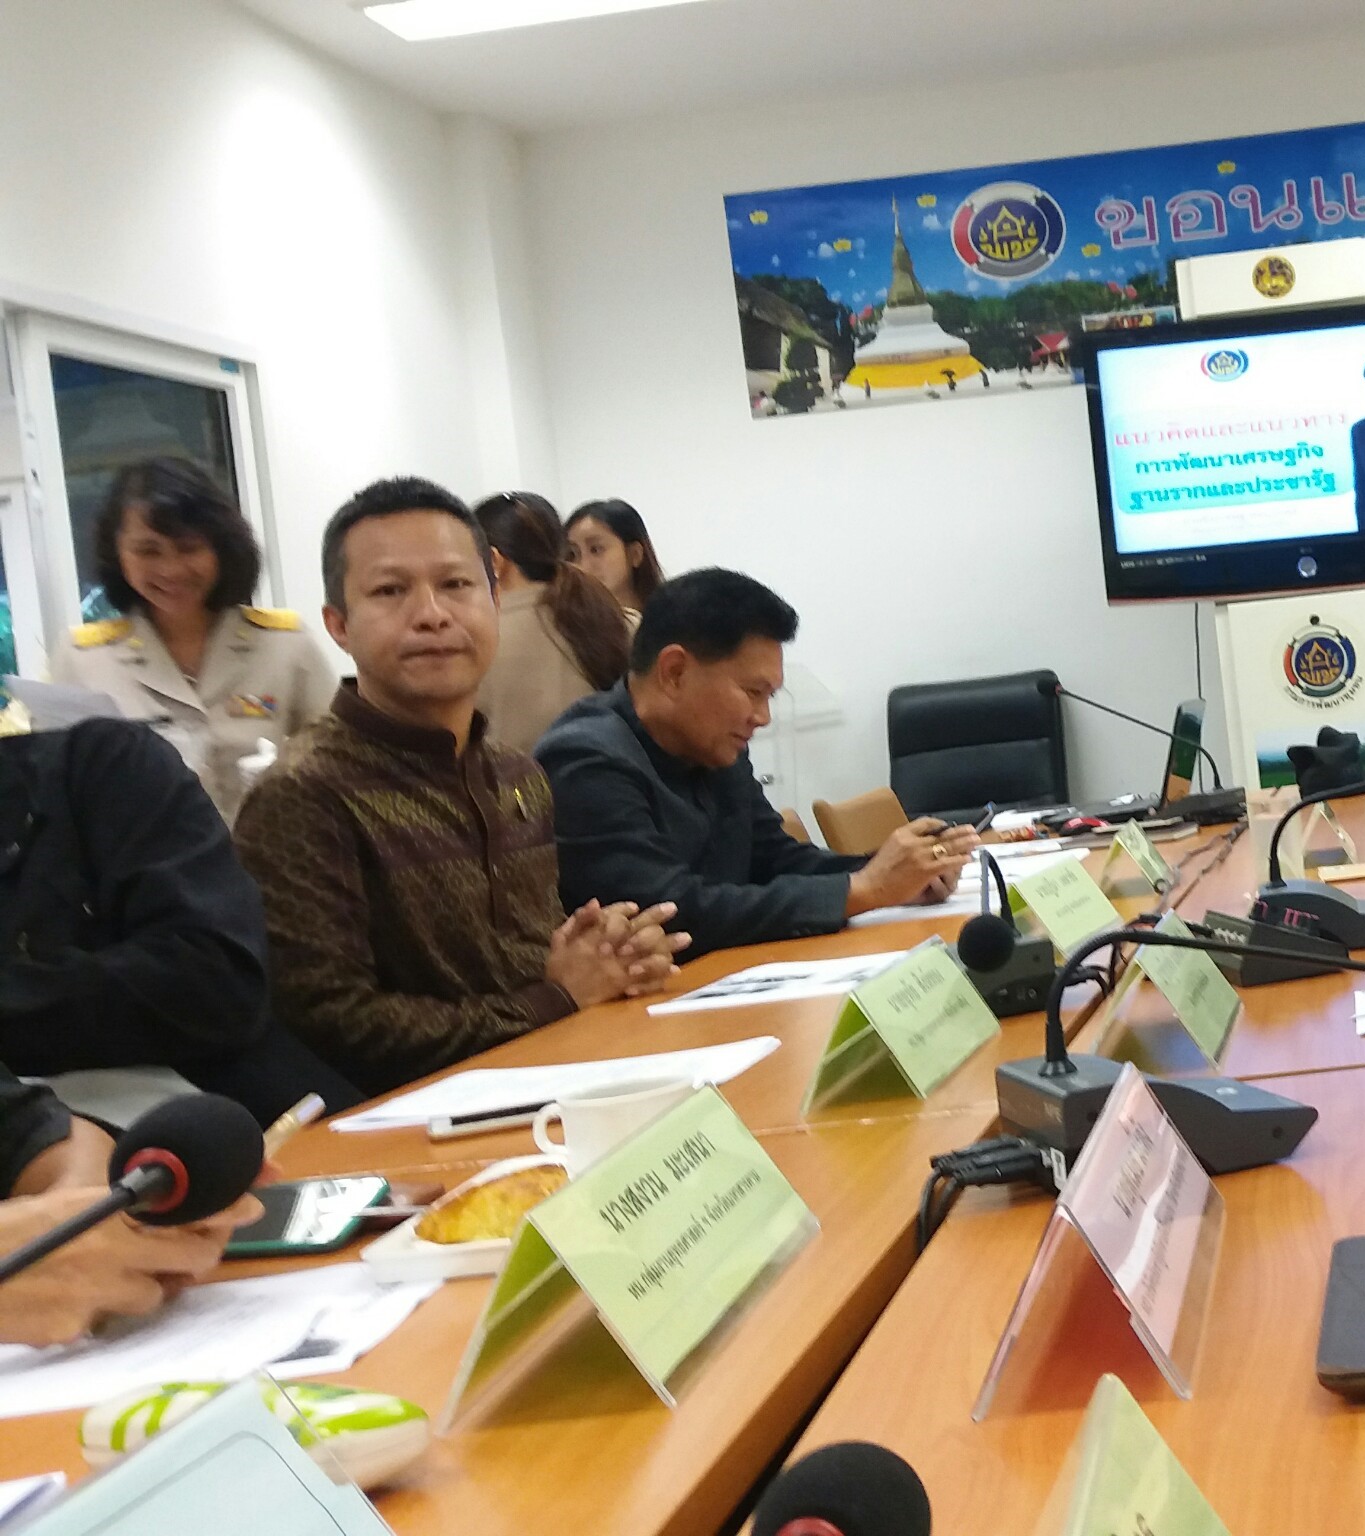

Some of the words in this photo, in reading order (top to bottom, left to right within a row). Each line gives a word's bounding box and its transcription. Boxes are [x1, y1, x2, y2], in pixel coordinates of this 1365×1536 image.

[1115, 412, 1347, 446] แนวคิดและแนวทาง
[1135, 441, 1325, 474] การพัฒนาเศรษฐกิจ
[1130, 469, 1336, 510] ฐานรากและประชารัฐ
[600, 1170, 669, 1234] นางสงวน
